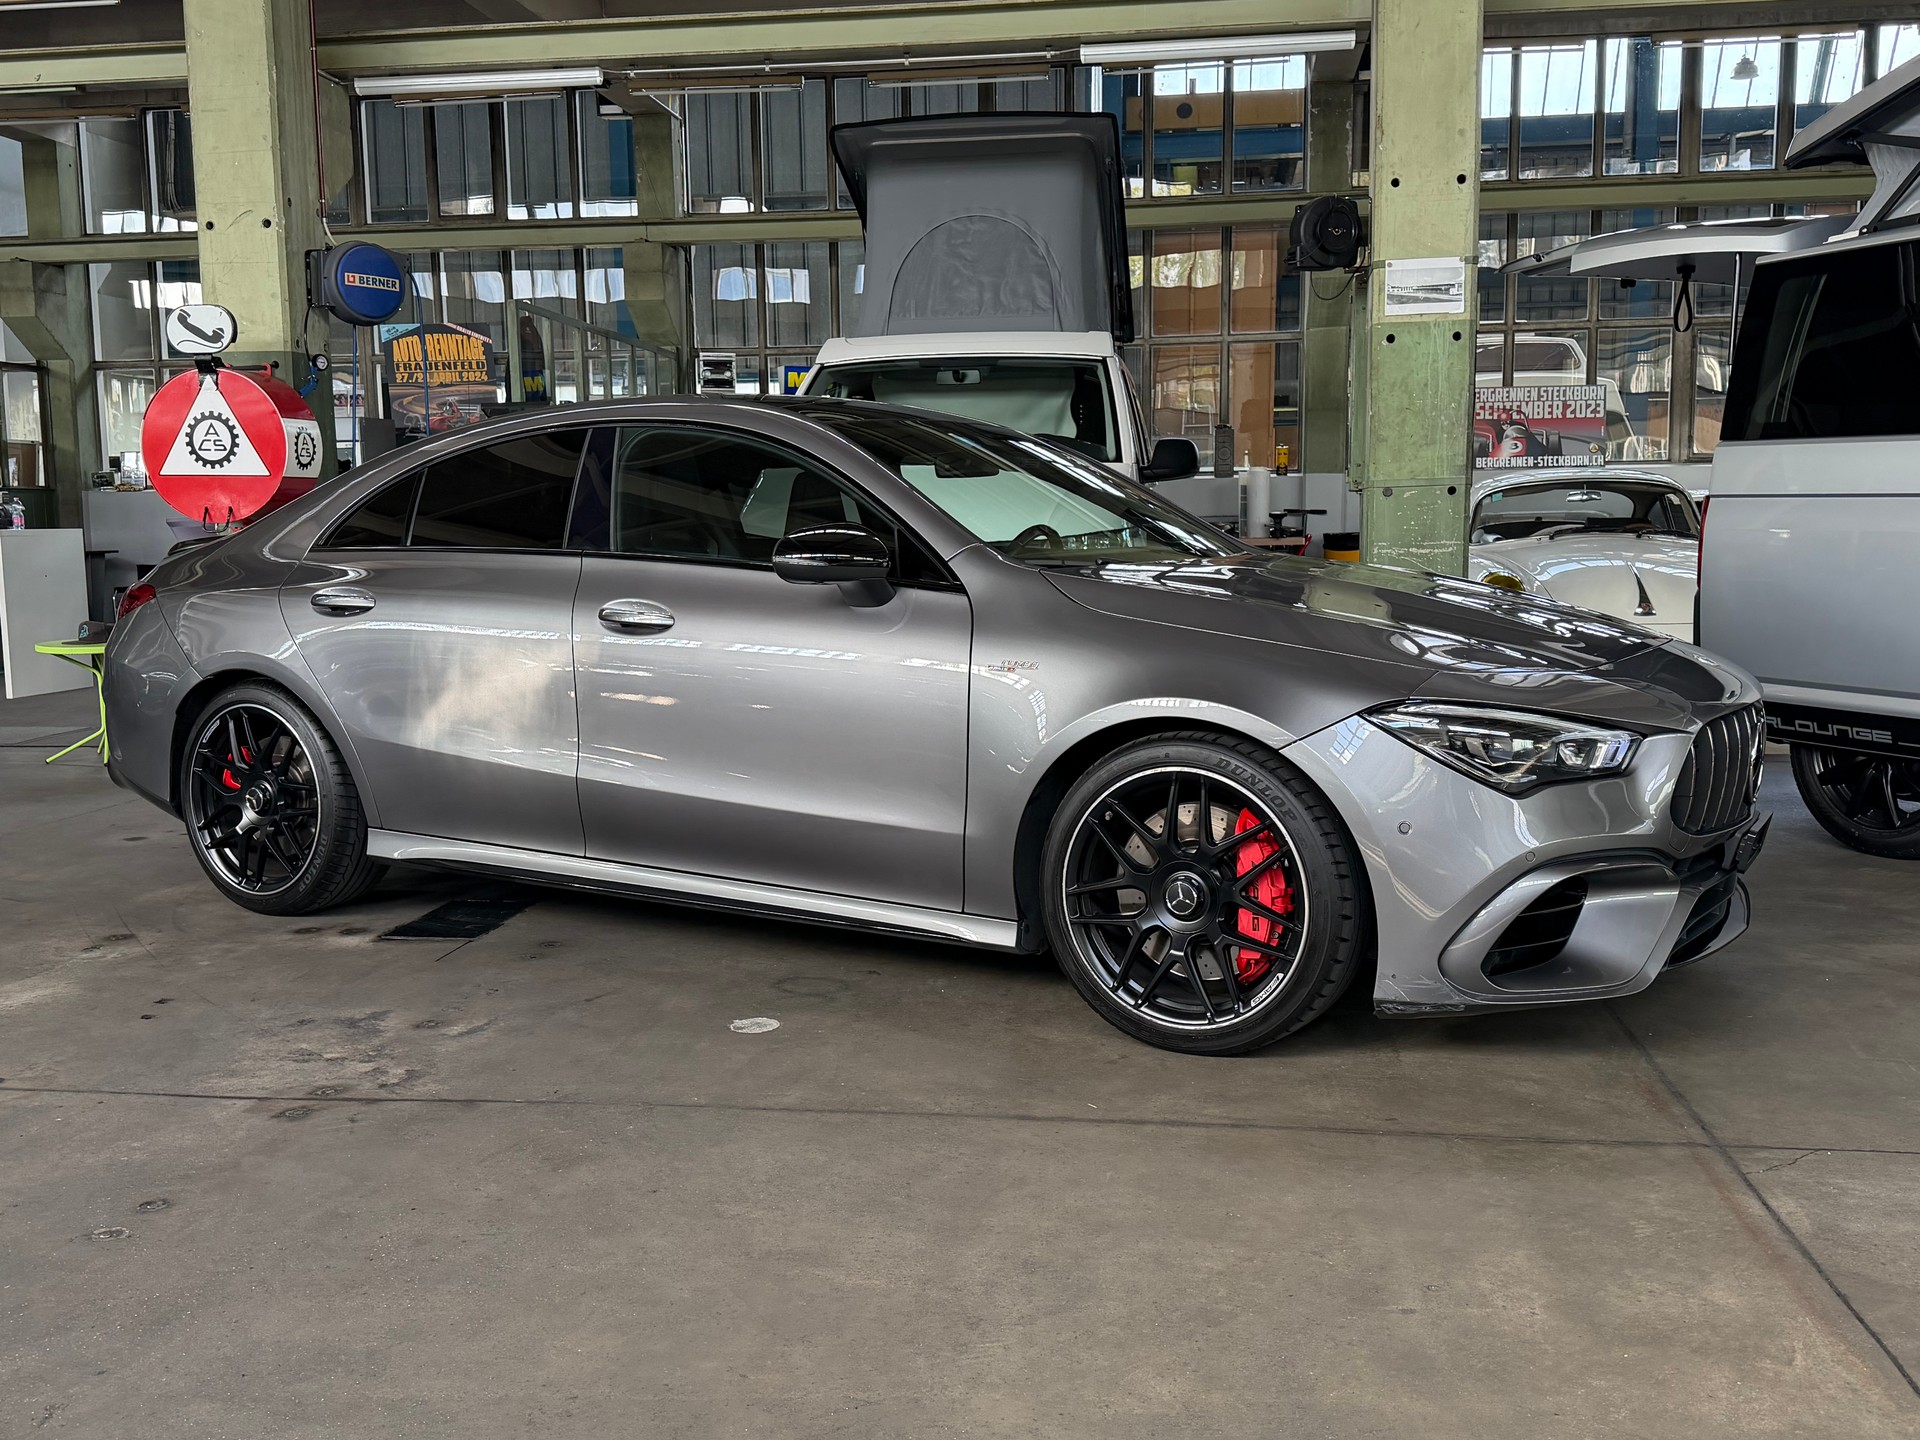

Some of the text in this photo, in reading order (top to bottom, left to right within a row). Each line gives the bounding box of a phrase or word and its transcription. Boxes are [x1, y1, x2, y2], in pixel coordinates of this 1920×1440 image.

[358, 275, 398, 290] BERNER
[395, 372, 489, 383] 27./2.APRIL 2024
[1475, 385, 1605, 402] ERGRENNEN STECKBORN
[1475, 400, 1605, 420] SEPTEMBER 2023
[1475, 455, 1605, 468] BERGRENNEN-STECKBORN.CH
[1766, 715, 1893, 744] RLOUNGE
[1213, 757, 1298, 821] DUNLOP
